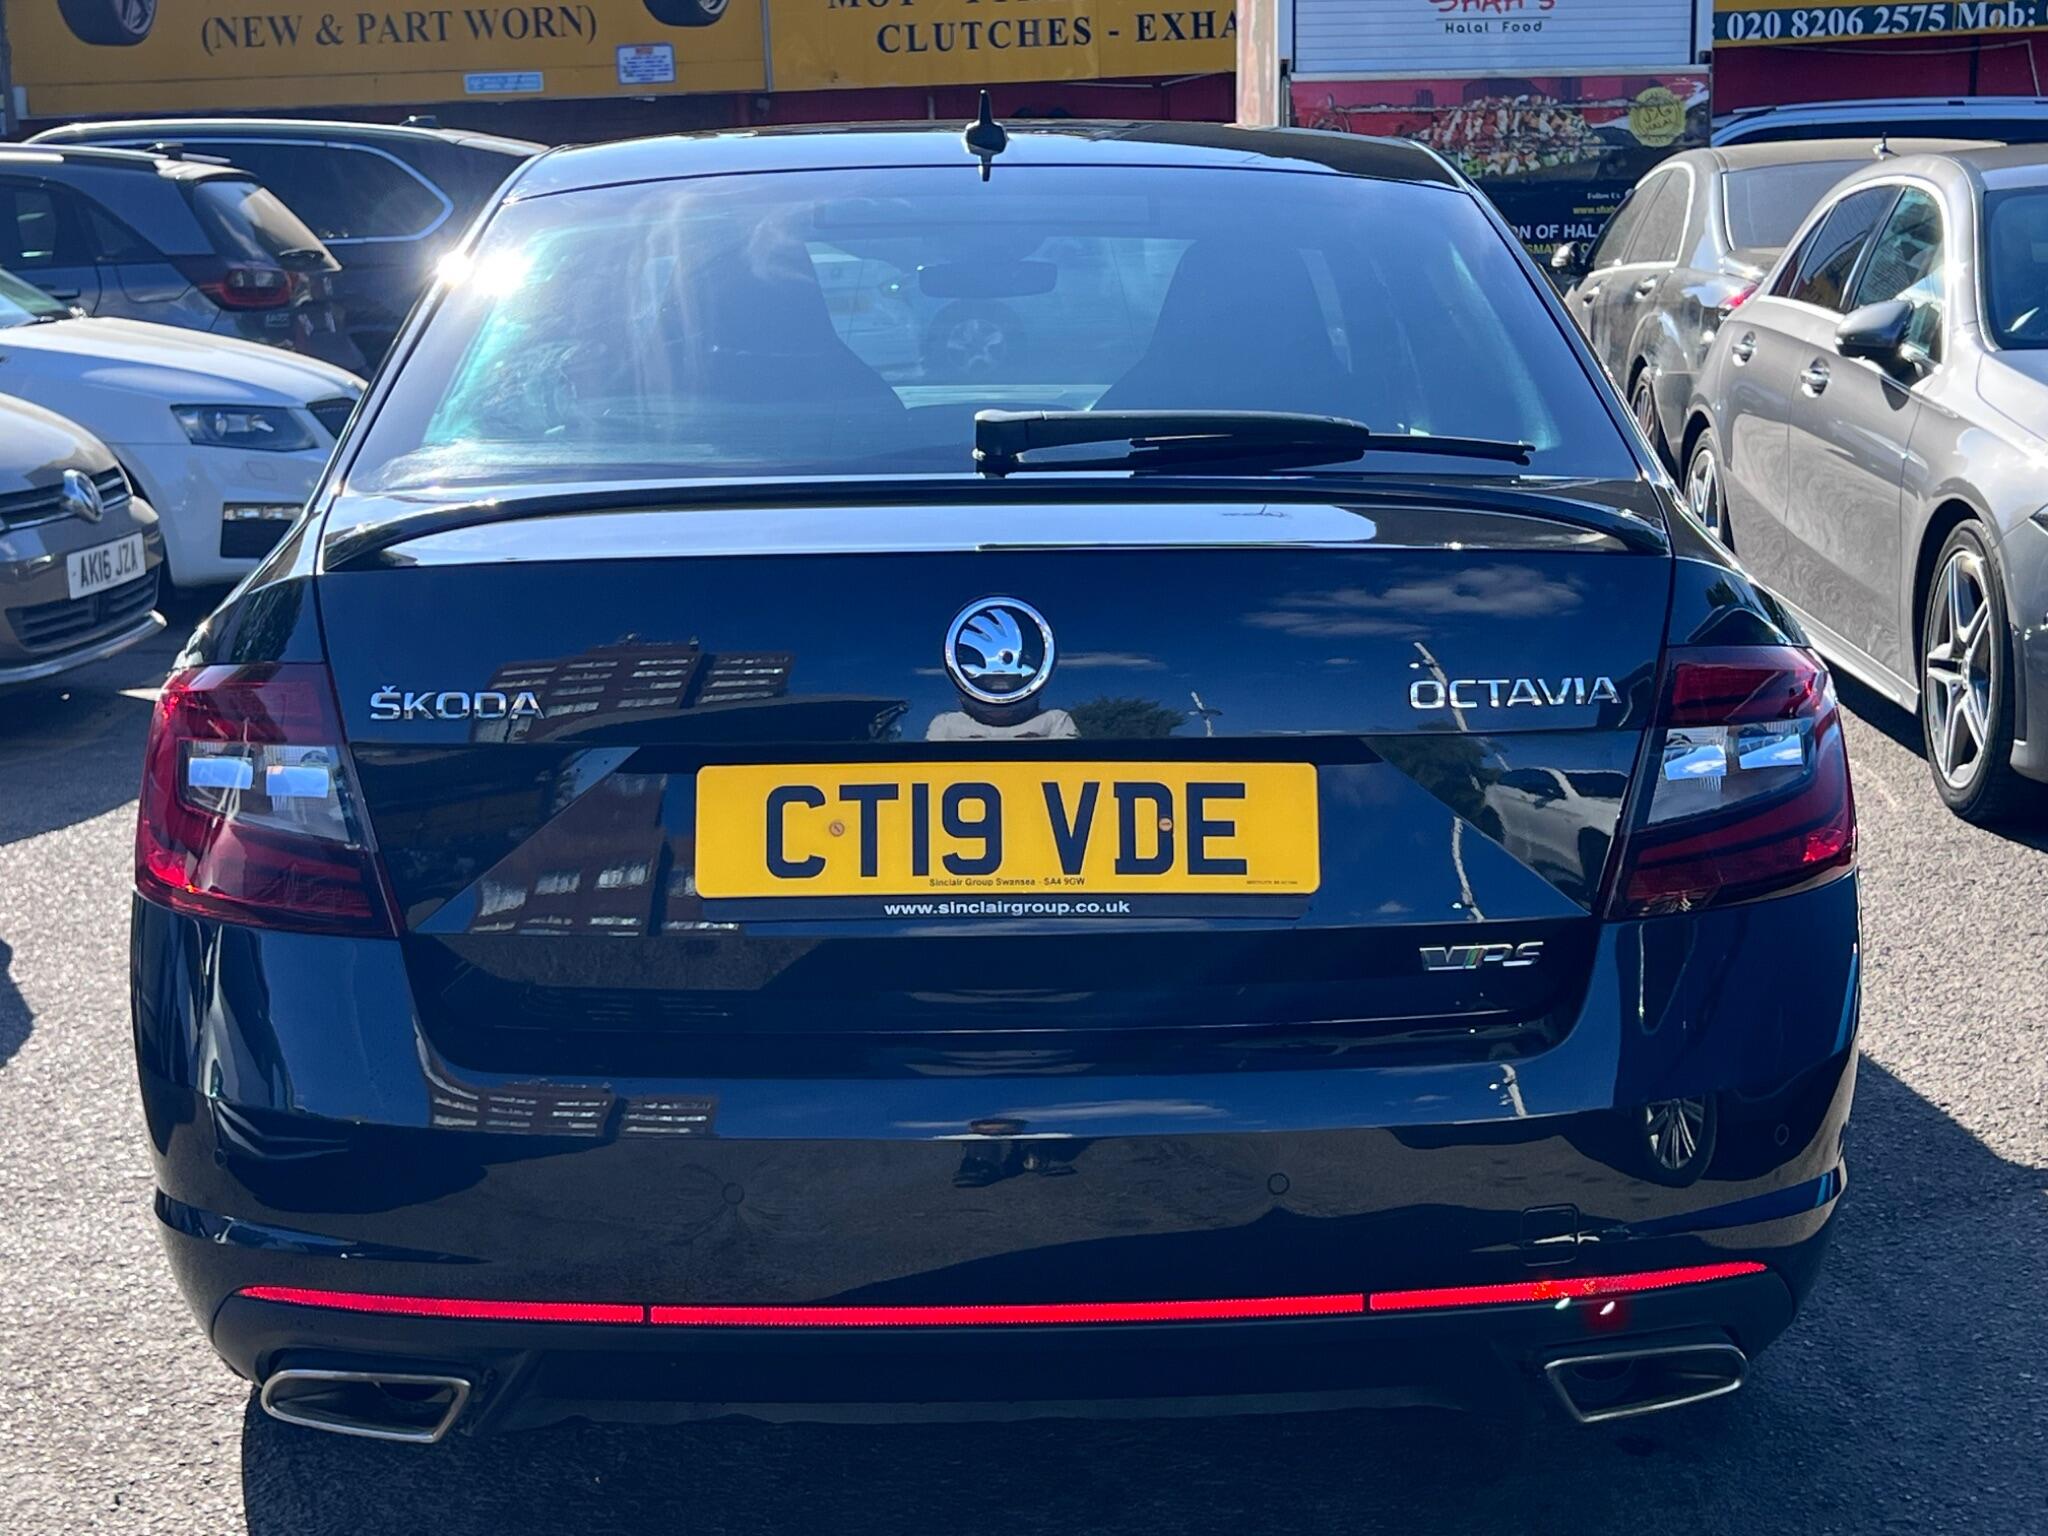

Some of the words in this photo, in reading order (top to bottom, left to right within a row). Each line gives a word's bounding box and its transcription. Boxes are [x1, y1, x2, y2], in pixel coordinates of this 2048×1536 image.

[202, 15, 303, 57] (NEW
[315, 13, 344, 46] &
[355, 10, 453, 45] PART
[463, 4, 597, 45] WORN)
[876, 16, 1092, 53] CLUTCHES
[1444, 22, 1489, 34] Halal
[1502, 21, 1542, 33] Food
[1726, 11, 1782, 40] 020
[1791, 10, 1864, 38] 8206
[1873, 4, 1946, 34] 2575
[1956, 1, 2036, 30] Mob:
[1535, 224, 1559, 239] OF
[80, 550, 112, 588] AK16
[115, 541, 138, 576] JZA
[370, 685, 545, 720] ŠKODA
[1410, 676, 1622, 710] OCTAVIA
[766, 783, 1001, 879] CT19
[1041, 782, 1247, 876] VDE
[929, 878, 962, 887] Sinclair
[965, 878, 993, 887] Group
[996, 878, 1036, 886] Swansea
[884, 900, 1130, 917] www.sinclairgroup.co.uk
